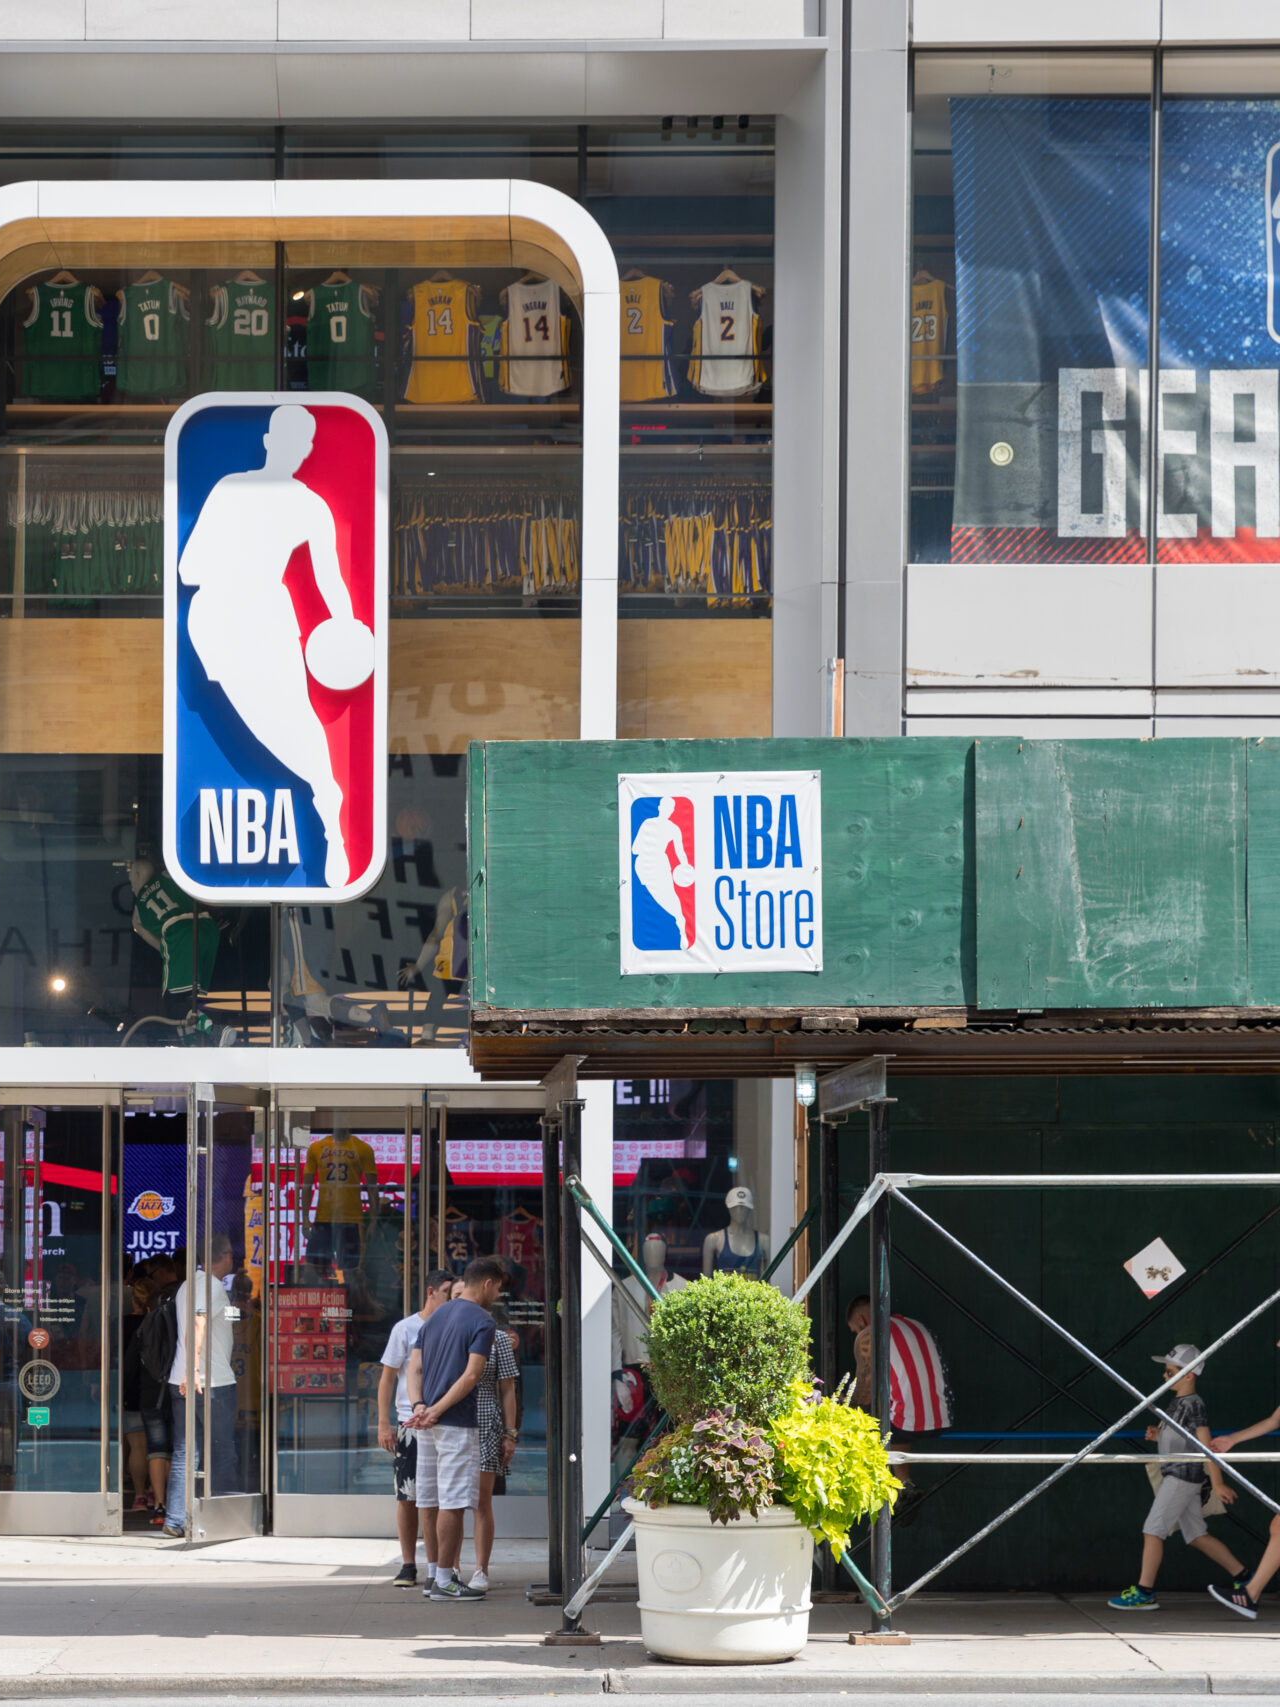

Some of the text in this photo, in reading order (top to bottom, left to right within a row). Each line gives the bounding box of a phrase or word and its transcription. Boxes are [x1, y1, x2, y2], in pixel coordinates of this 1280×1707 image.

[138, 300, 161, 312] TATUM
[326, 301, 348, 312] TATUM
[50, 310, 73, 337] 11
[143, 313, 160, 340] 0
[233, 308, 269, 336] 20
[330, 316, 347, 343] 0
[427, 308, 453, 336] 14
[523, 315, 549, 342] 14
[626, 308, 643, 334] 2
[720, 316, 735, 341] 2
[911, 314, 937, 343] 23
[199, 788, 300, 865] NBA
[713, 794, 803, 870] NBA
[146, 888, 178, 921] 11
[714, 875, 815, 951] Store
[325, 1162, 349, 1182] 23
[126, 1231, 180, 1250] JUST
[322, 1291, 345, 1306] Action
